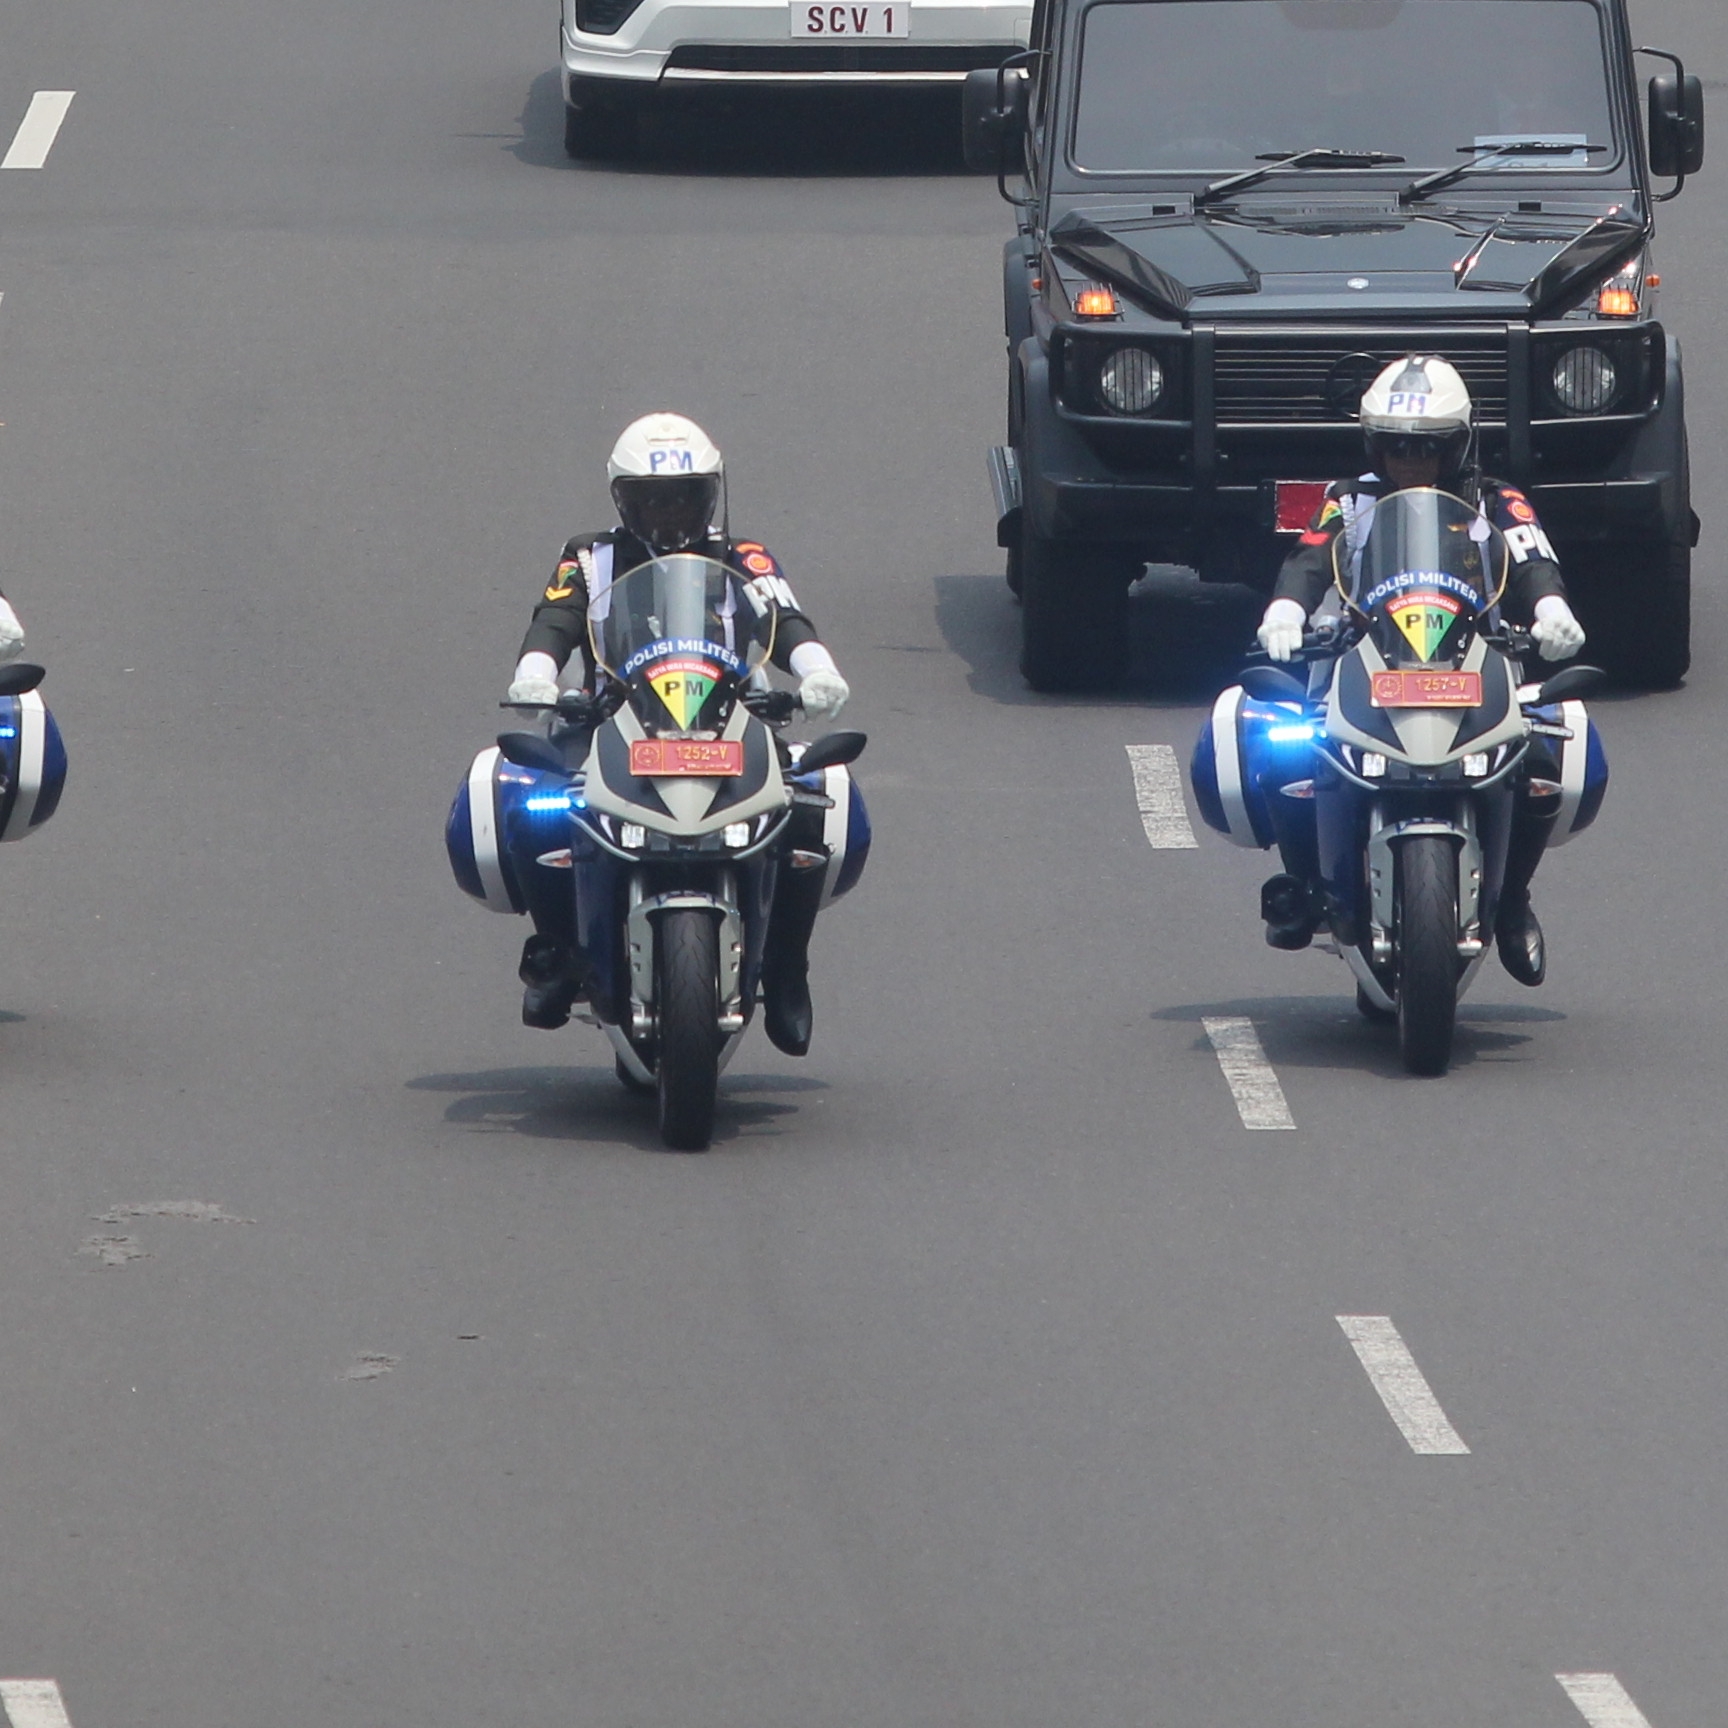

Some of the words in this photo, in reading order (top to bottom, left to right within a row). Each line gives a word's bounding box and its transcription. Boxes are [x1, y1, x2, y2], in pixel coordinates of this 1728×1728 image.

[883, 7, 893, 33] 1
[1388, 393, 1426, 414] PM
[649, 450, 692, 471] PM
[1367, 572, 1414, 605] POLISI
[1419, 572, 1478, 604] MILITER
[1405, 614, 1443, 629] PM
[625, 641, 673, 674] POLISI
[677, 640, 739, 670] MILITER
[664, 681, 703, 696] PM
[676, 746, 728, 760] 1252-V
